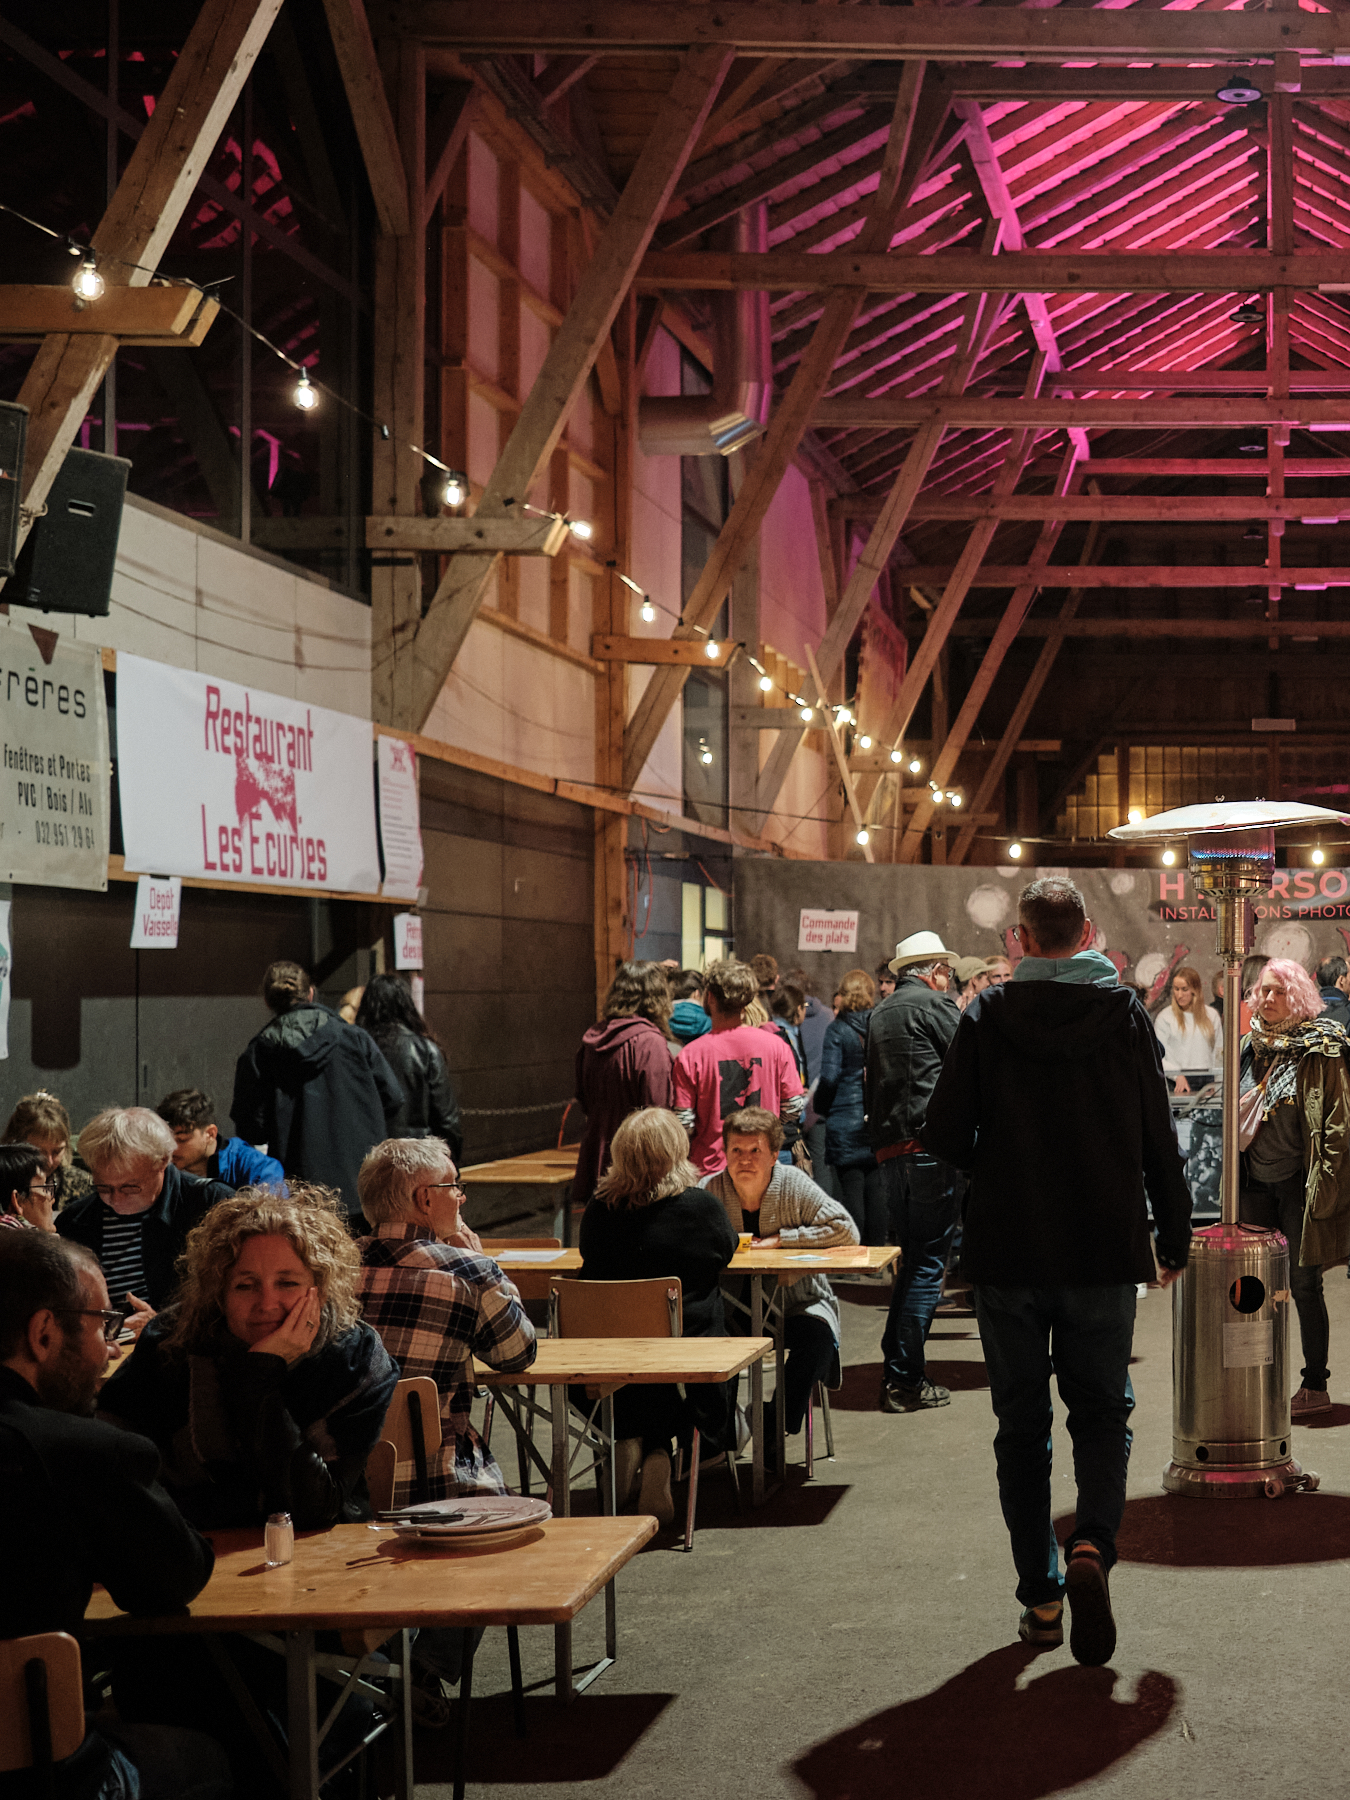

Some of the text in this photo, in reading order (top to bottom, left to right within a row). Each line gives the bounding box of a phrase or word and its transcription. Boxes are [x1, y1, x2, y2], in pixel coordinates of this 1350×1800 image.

[0, 667, 86, 718] rères
[204, 684, 314, 772] Restaurant
[48, 754, 57, 777] et
[60, 754, 91, 783] Portes
[18, 781, 36, 808] PVC
[46, 786, 67, 813] Bois
[36, 820, 51, 845] 032
[53, 822, 69, 848] 951
[72, 825, 83, 849] 29
[201, 803, 243, 873] Les
[250, 812, 327, 881] Ecuries
[150, 887, 174, 918] Dépôt
[1159, 905, 1292, 920] INSTALONS
[802, 915, 856, 930] Commande
[805, 930, 850, 947] des plats
